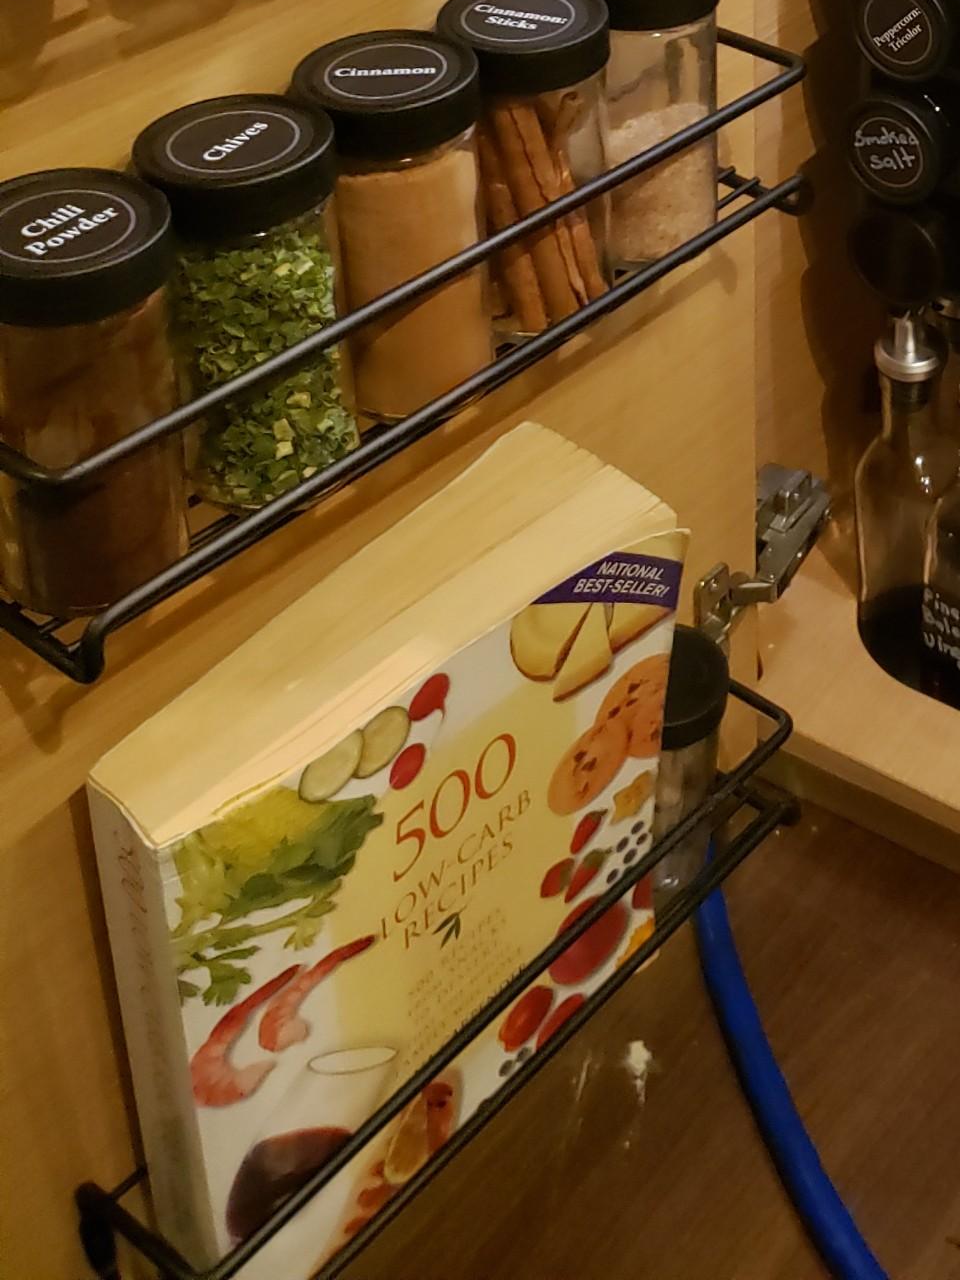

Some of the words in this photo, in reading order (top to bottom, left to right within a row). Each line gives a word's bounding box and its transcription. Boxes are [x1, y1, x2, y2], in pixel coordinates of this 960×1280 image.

[473, 4, 568, 25] Cinnamon:
[484, 15, 538, 31] Sticks
[873, 8, 922, 47] Peppercorn:
[888, 24, 922, 53] Tricolor
[334, 66, 436, 78] Cinnamon
[202, 120, 269, 162] Chives
[854, 127, 919, 147] Smoked
[20, 204, 86, 238] Chili
[23, 206, 120, 257] Powder
[597, 561, 665, 581] NATIONAL
[573, 578, 671, 598] BEST-SELLER!
[393, 733, 517, 883] 500
